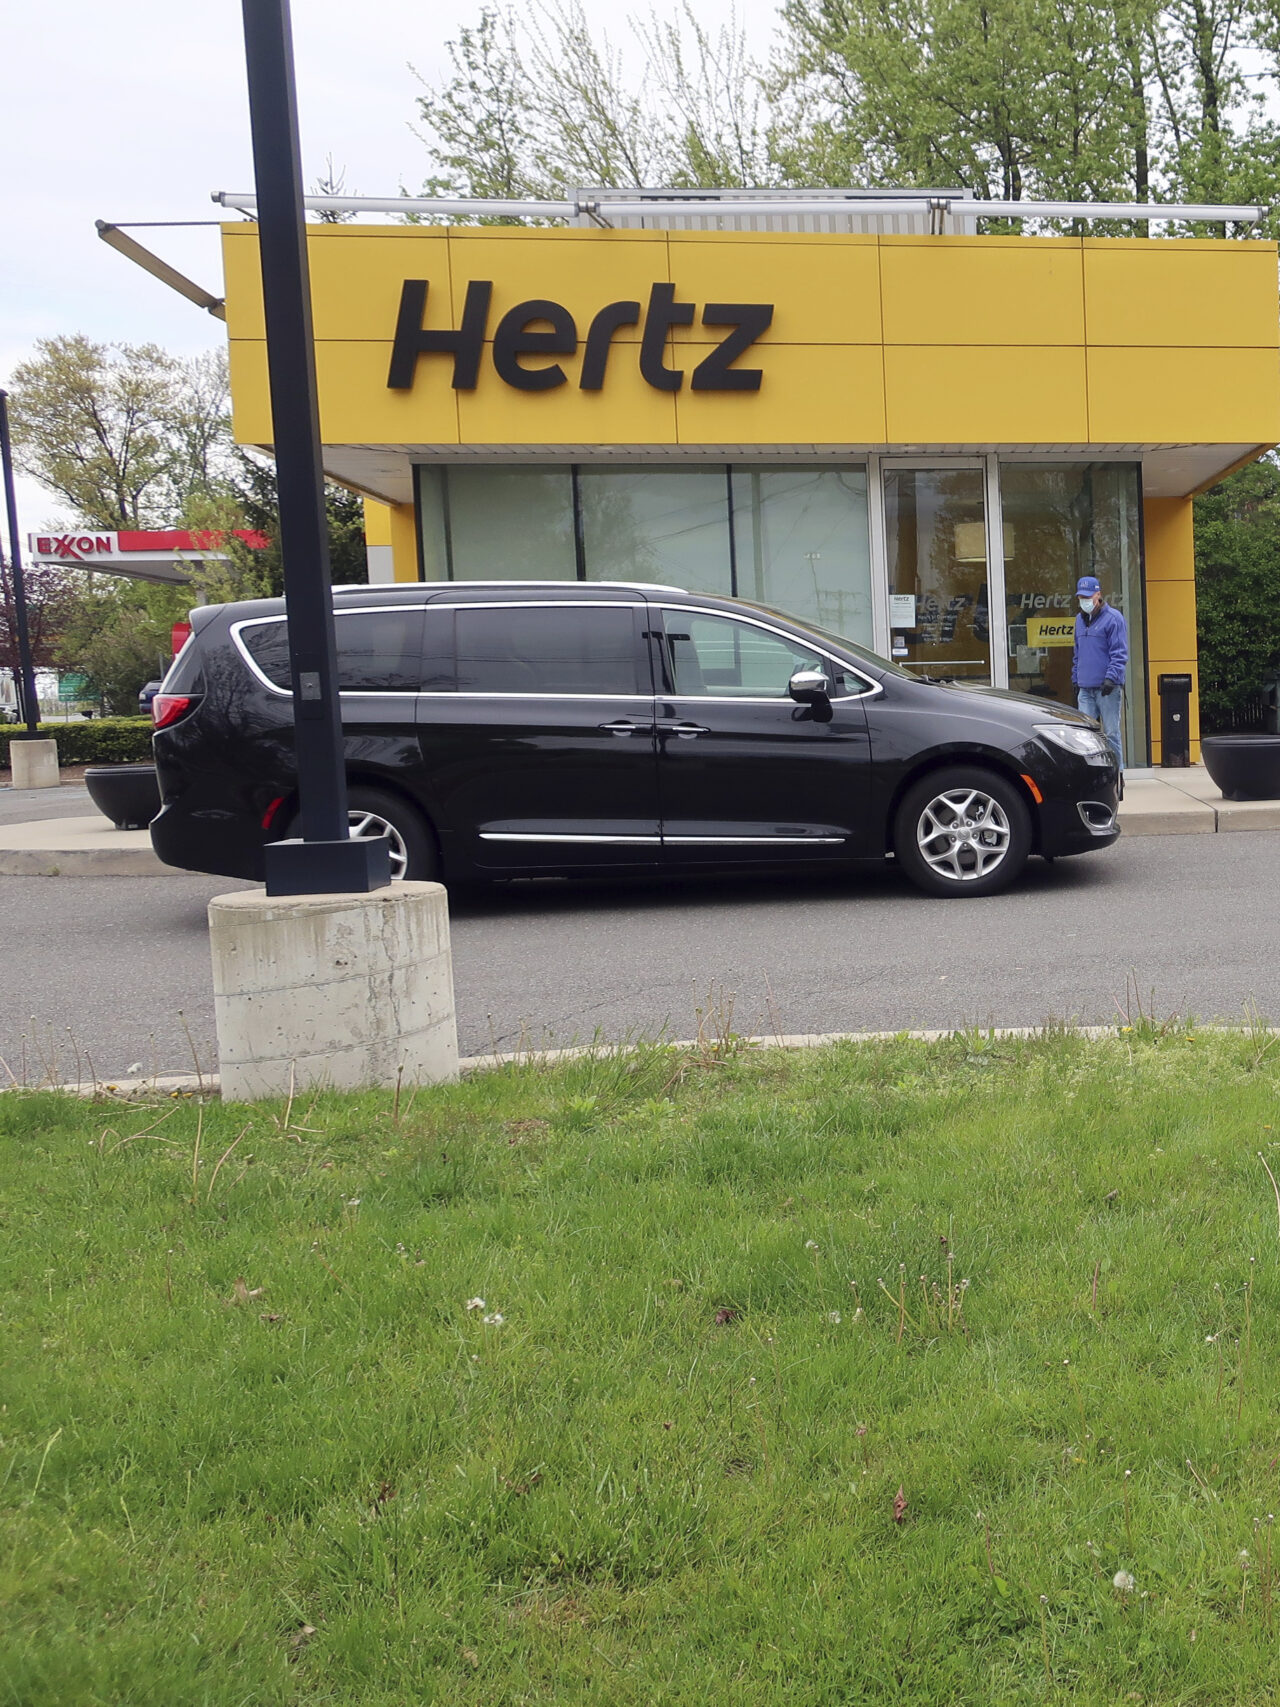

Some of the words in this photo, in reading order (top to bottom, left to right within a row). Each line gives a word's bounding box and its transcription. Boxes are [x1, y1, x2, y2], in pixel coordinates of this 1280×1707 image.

[387, 279, 774, 391] Hertz
[37, 534, 112, 560] EXXON
[1020, 593, 1071, 608] Hertz
[1039, 624, 1074, 635] Hertz
